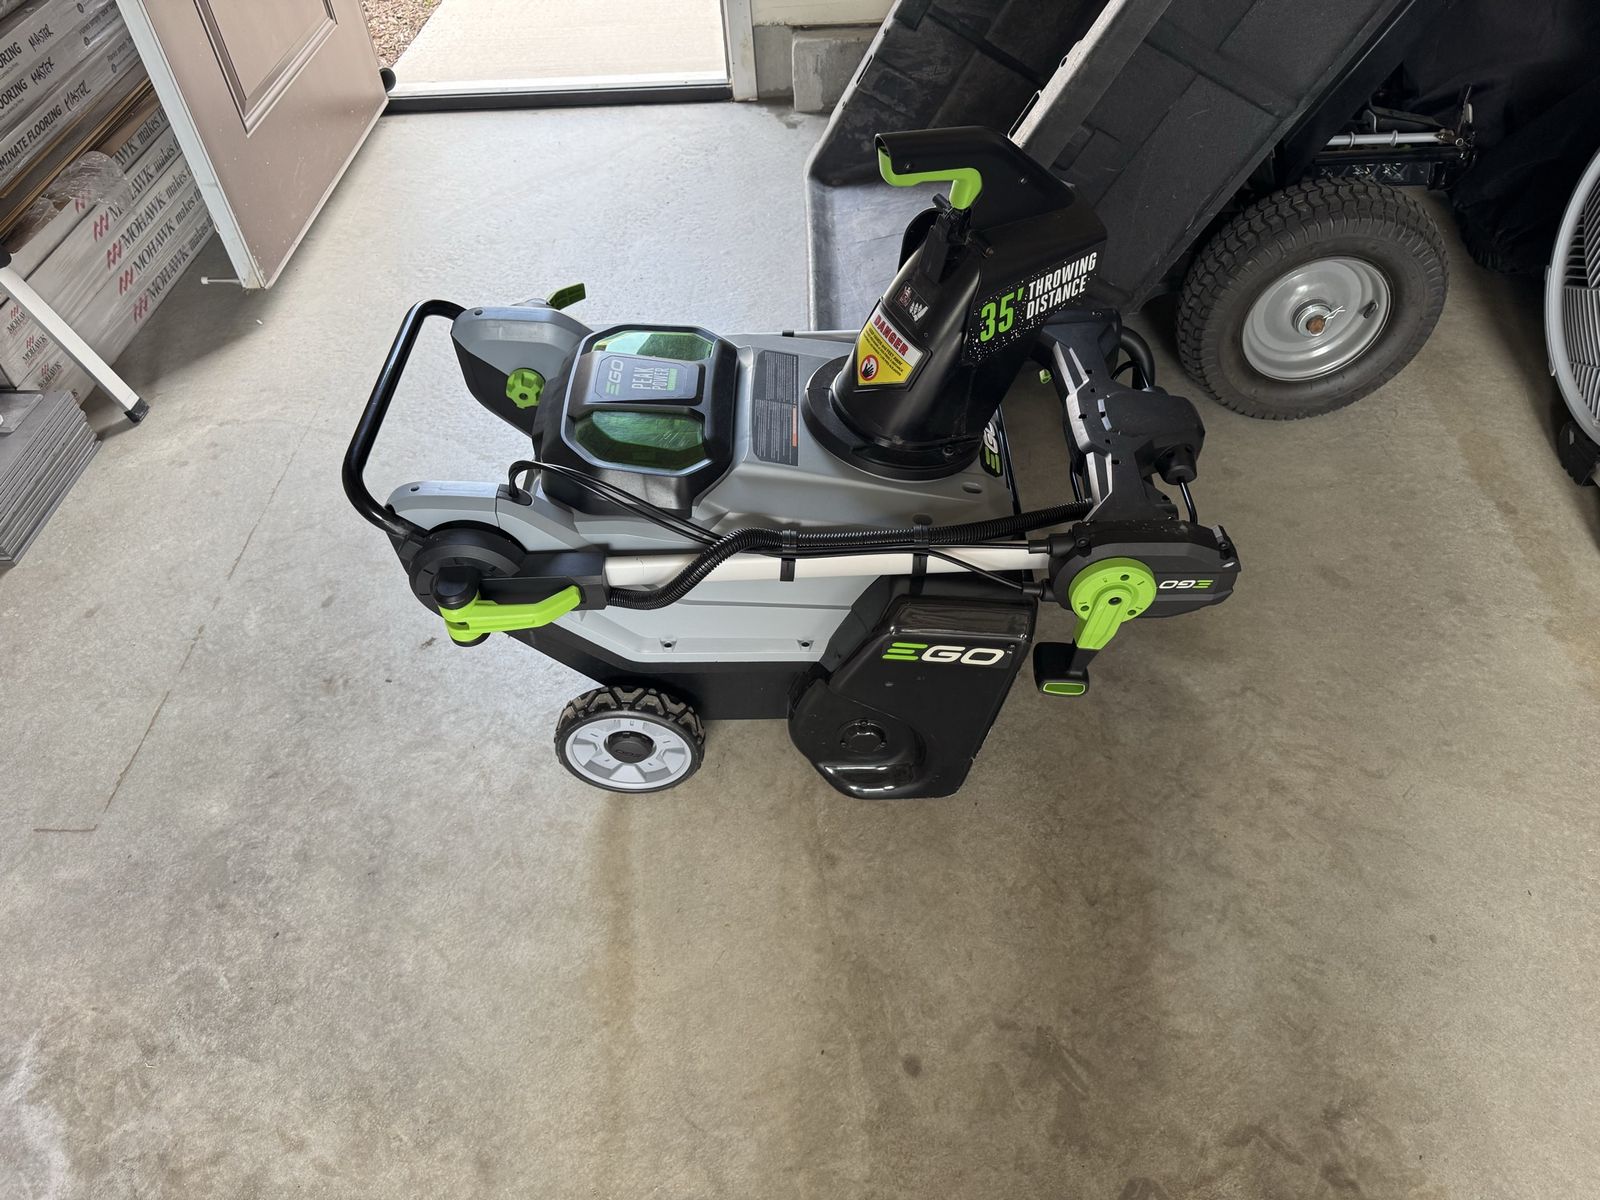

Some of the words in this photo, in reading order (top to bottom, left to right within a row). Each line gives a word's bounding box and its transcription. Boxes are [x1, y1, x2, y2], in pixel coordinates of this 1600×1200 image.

[26, 104, 63, 143] FLOORING
[137, 116, 160, 145] makes
[153, 147, 176, 172] makes
[120, 193, 167, 250] MOHAWK
[165, 170, 187, 199] makes
[133, 220, 176, 275] MOHAWK
[175, 197, 196, 225] makes
[147, 247, 190, 302] MOHAWK
[1029, 252, 1097, 300] THROWING
[980, 287, 1024, 342] 35'
[1026, 274, 1087, 320] DISTANCE
[873, 314, 909, 357] DANGER
[606, 359, 624, 396] EGO
[632, 367, 655, 390] PEAK
[652, 368, 670, 391] POWER
[1159, 580, 1213, 589] EGO
[882, 642, 1005, 665] EGO
